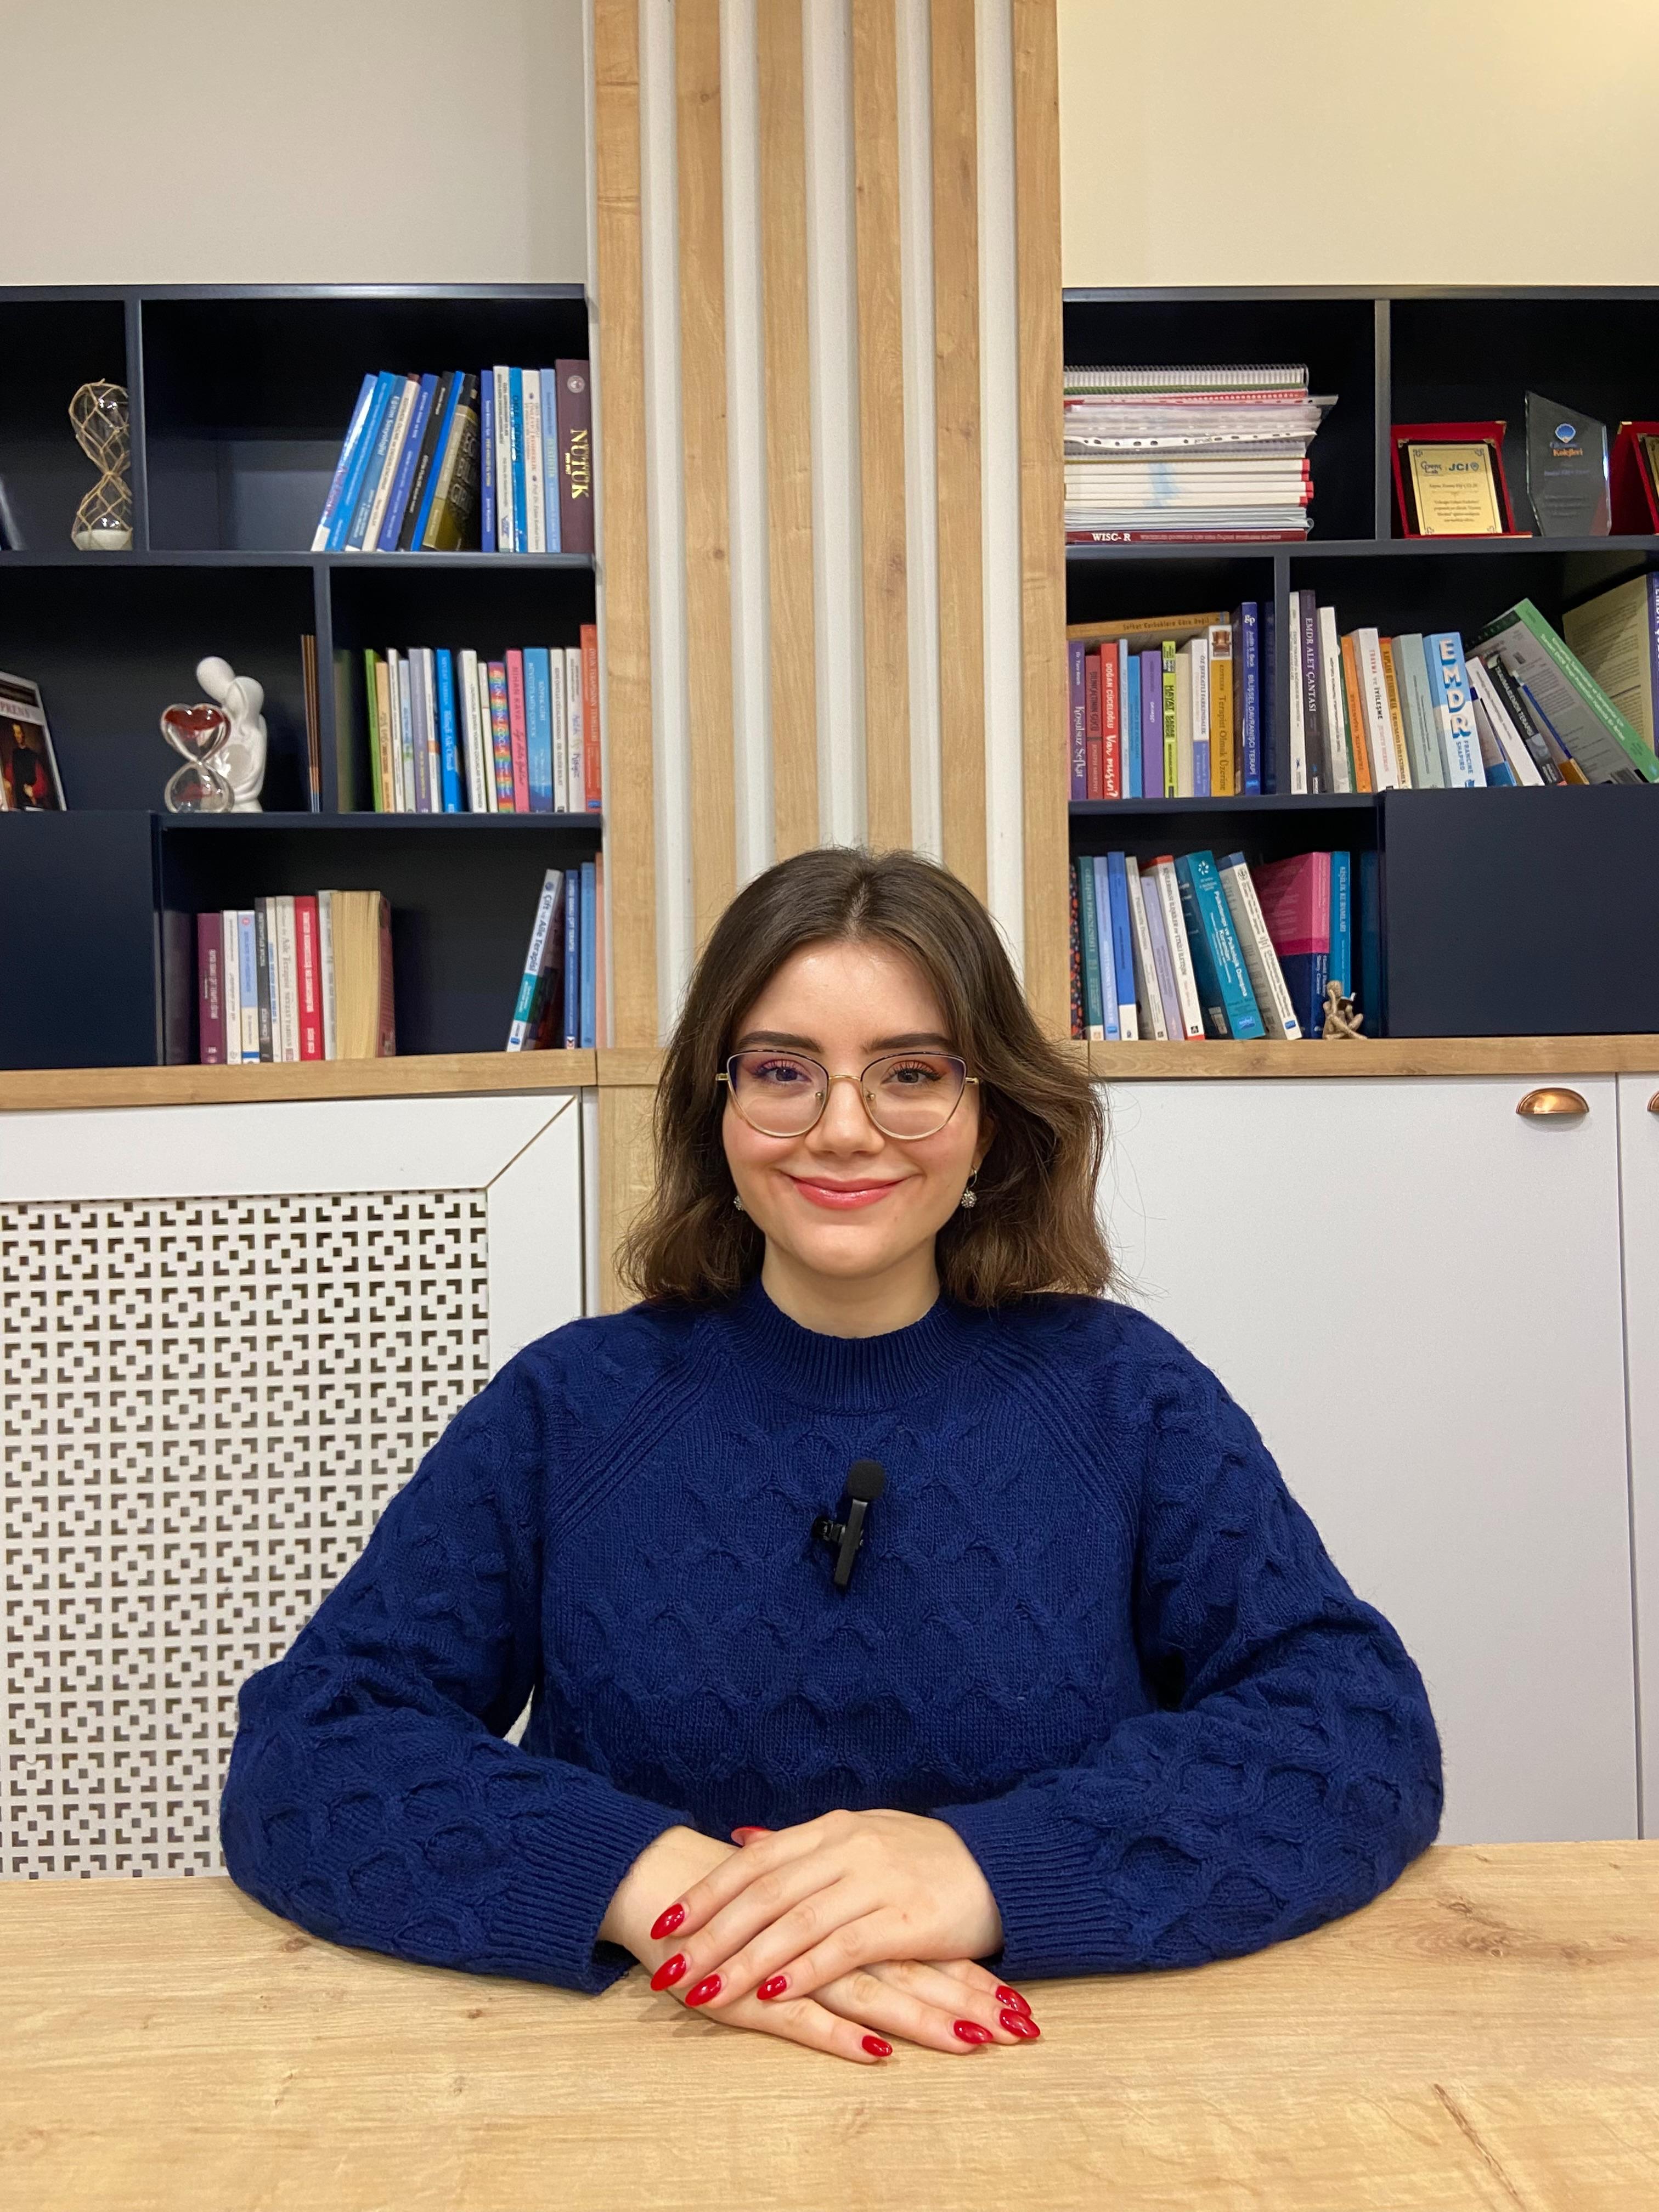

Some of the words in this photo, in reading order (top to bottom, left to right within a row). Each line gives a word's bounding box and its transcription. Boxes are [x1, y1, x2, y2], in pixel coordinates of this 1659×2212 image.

[568, 427, 591, 499] NUTUK
[1091, 533, 1122, 541] WISC-
[1124, 533, 1131, 541] R
[1304, 617, 1313, 644] EMDR
[1306, 646, 1314, 669] ALET
[1105, 663, 1114, 687] DOĞAN
[1246, 674, 1255, 704] BİLİŞSEL
[1438, 637, 1471, 739] EMDR
[1305, 671, 1316, 711] ÇANTASI
[1373, 687, 1385, 719] İYİLEŞME
[514, 697, 522, 720] KAYA
[1105, 689, 1115, 728] CÜCELOĞLU
[1217, 696, 1226, 728] Terapist
[1074, 706, 1085, 745] Koşulsuz
[1246, 706, 1255, 748] DAVRANIŞÇI
[1105, 735, 1116, 755] Var
[1456, 741, 1465, 771] SHAPIRO
[1463, 740, 1473, 774] FRANCINE
[1073, 748, 1085, 777] Şefkat
[1220, 759, 1229, 790] Üzerine
[541, 893, 552, 910] Çift
[535, 919, 547, 937] Aile
[528, 938, 543, 972] Terapisi
